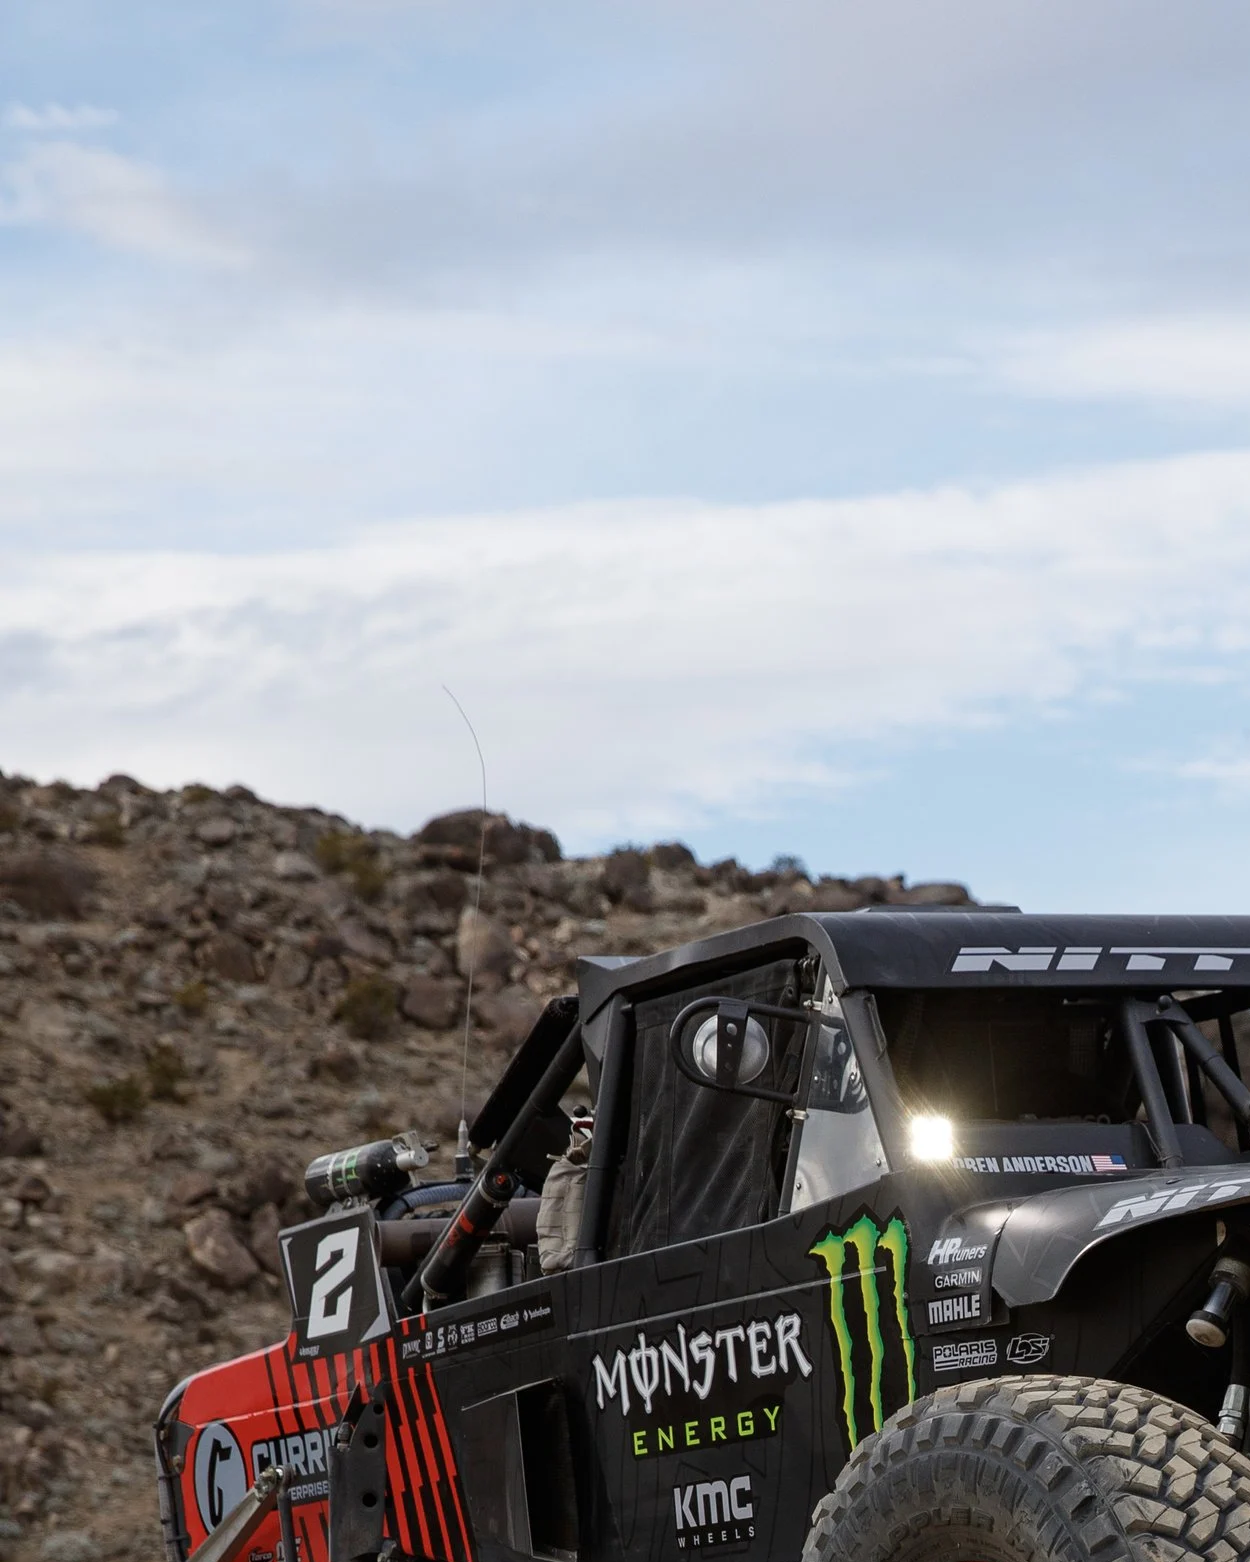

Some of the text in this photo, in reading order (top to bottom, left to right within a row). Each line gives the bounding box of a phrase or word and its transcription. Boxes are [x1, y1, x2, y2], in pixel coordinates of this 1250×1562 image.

[1003, 1154, 1094, 1174] ANDERSON
[307, 1226, 360, 1340] 2
[934, 1270, 980, 1289] GARMIN
[928, 1294, 981, 1325] MAHLE
[933, 1339, 997, 1359] POLARIS
[958, 1353, 998, 1368] RACING
[592, 1312, 813, 1417] MONSTER
[633, 1405, 781, 1456] ENERGY
[252, 1426, 339, 1484] CURRI
[677, 1526, 755, 1548] WHEELS
